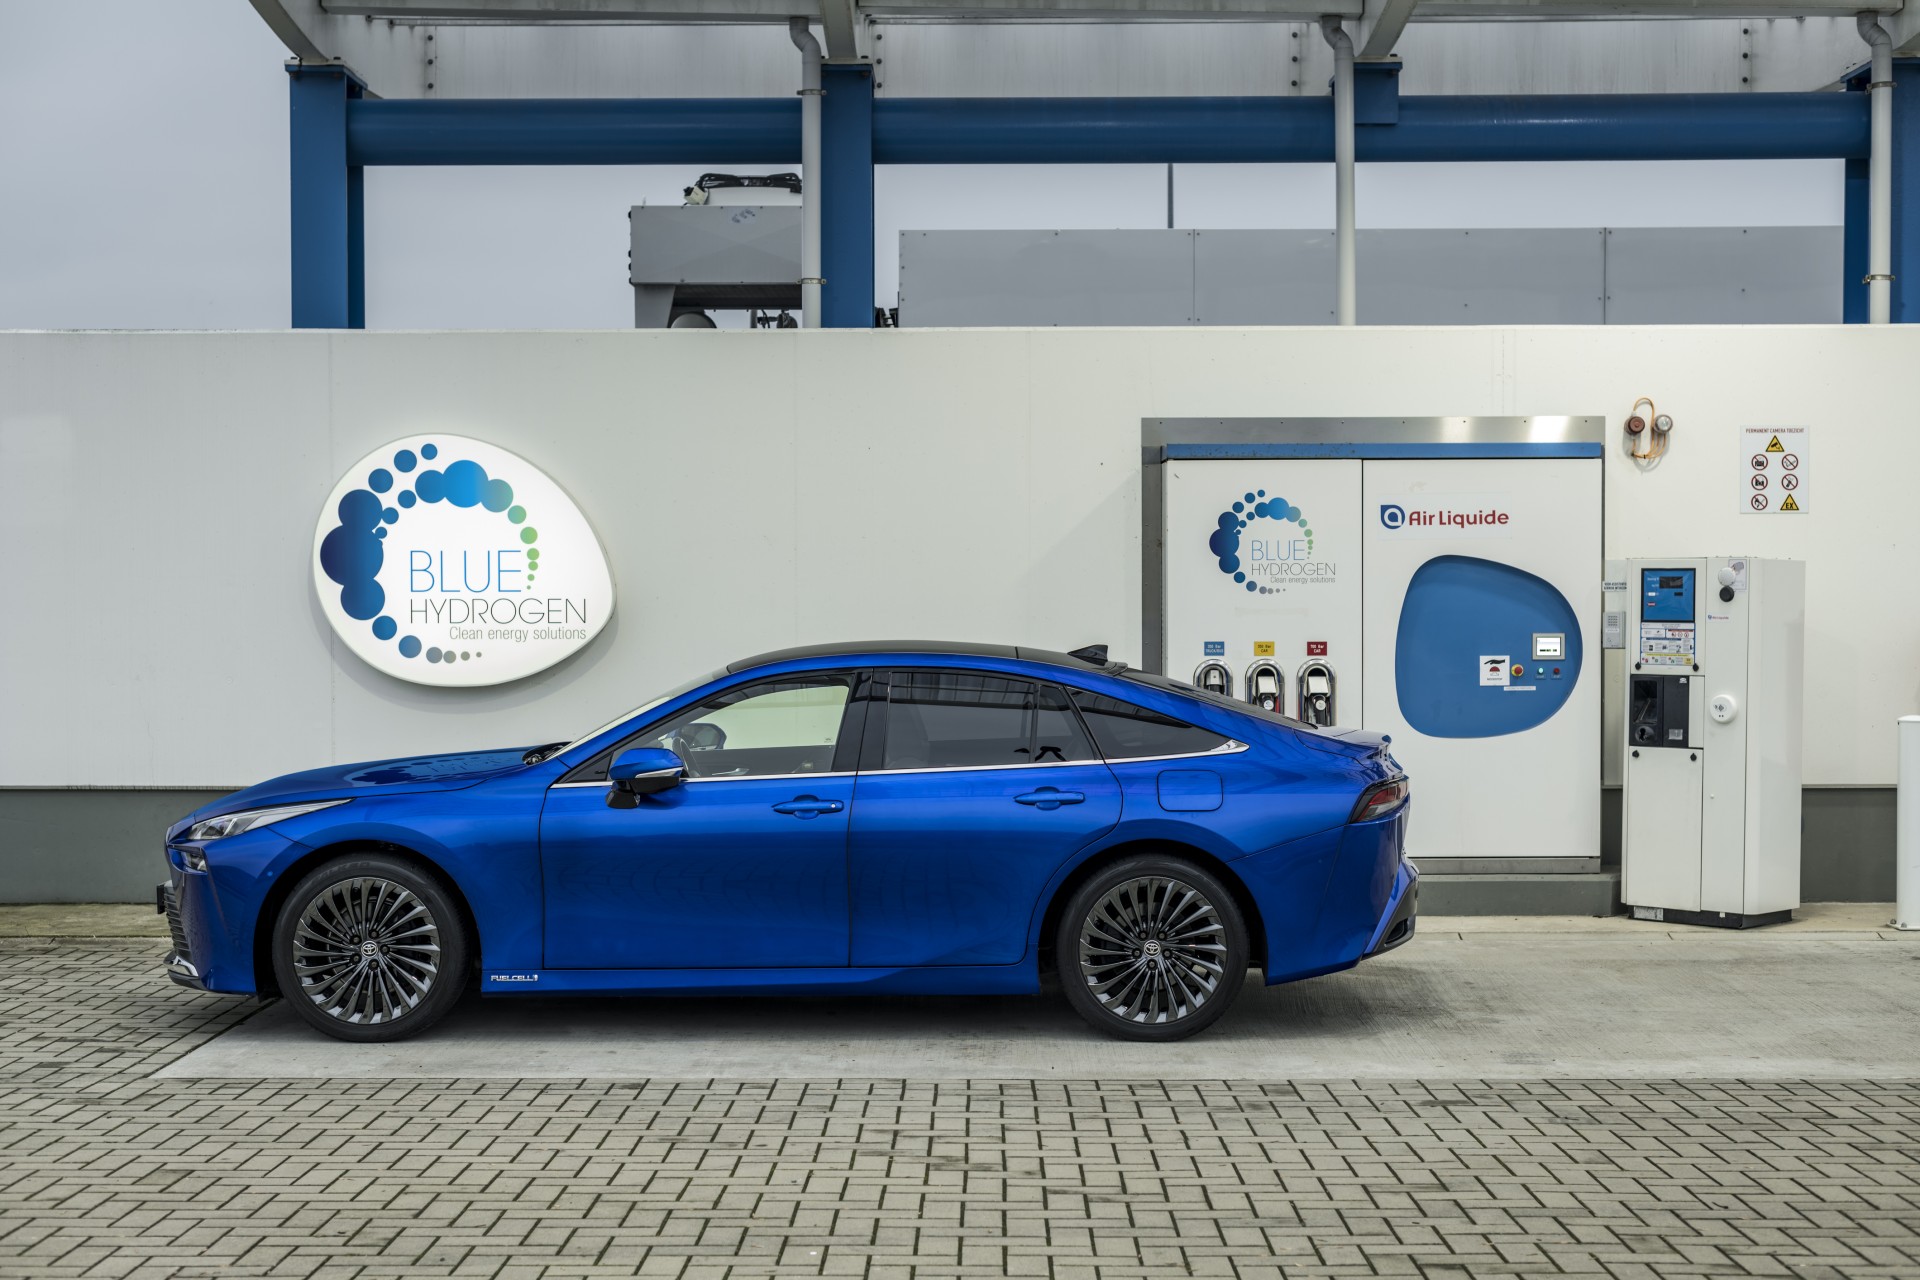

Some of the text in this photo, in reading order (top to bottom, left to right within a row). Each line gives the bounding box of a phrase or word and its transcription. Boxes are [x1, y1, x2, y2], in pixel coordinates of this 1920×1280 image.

[1408, 510, 1510, 529] Air Liquide
[1251, 539, 1305, 561] BLUE
[410, 550, 522, 593] BLUE
[1251, 562, 1336, 576] HYDROGEN
[1270, 576, 1336, 585] Clean energy solutions
[410, 597, 587, 625] HYDROGEN
[449, 626, 587, 643] Clean energy solutions
